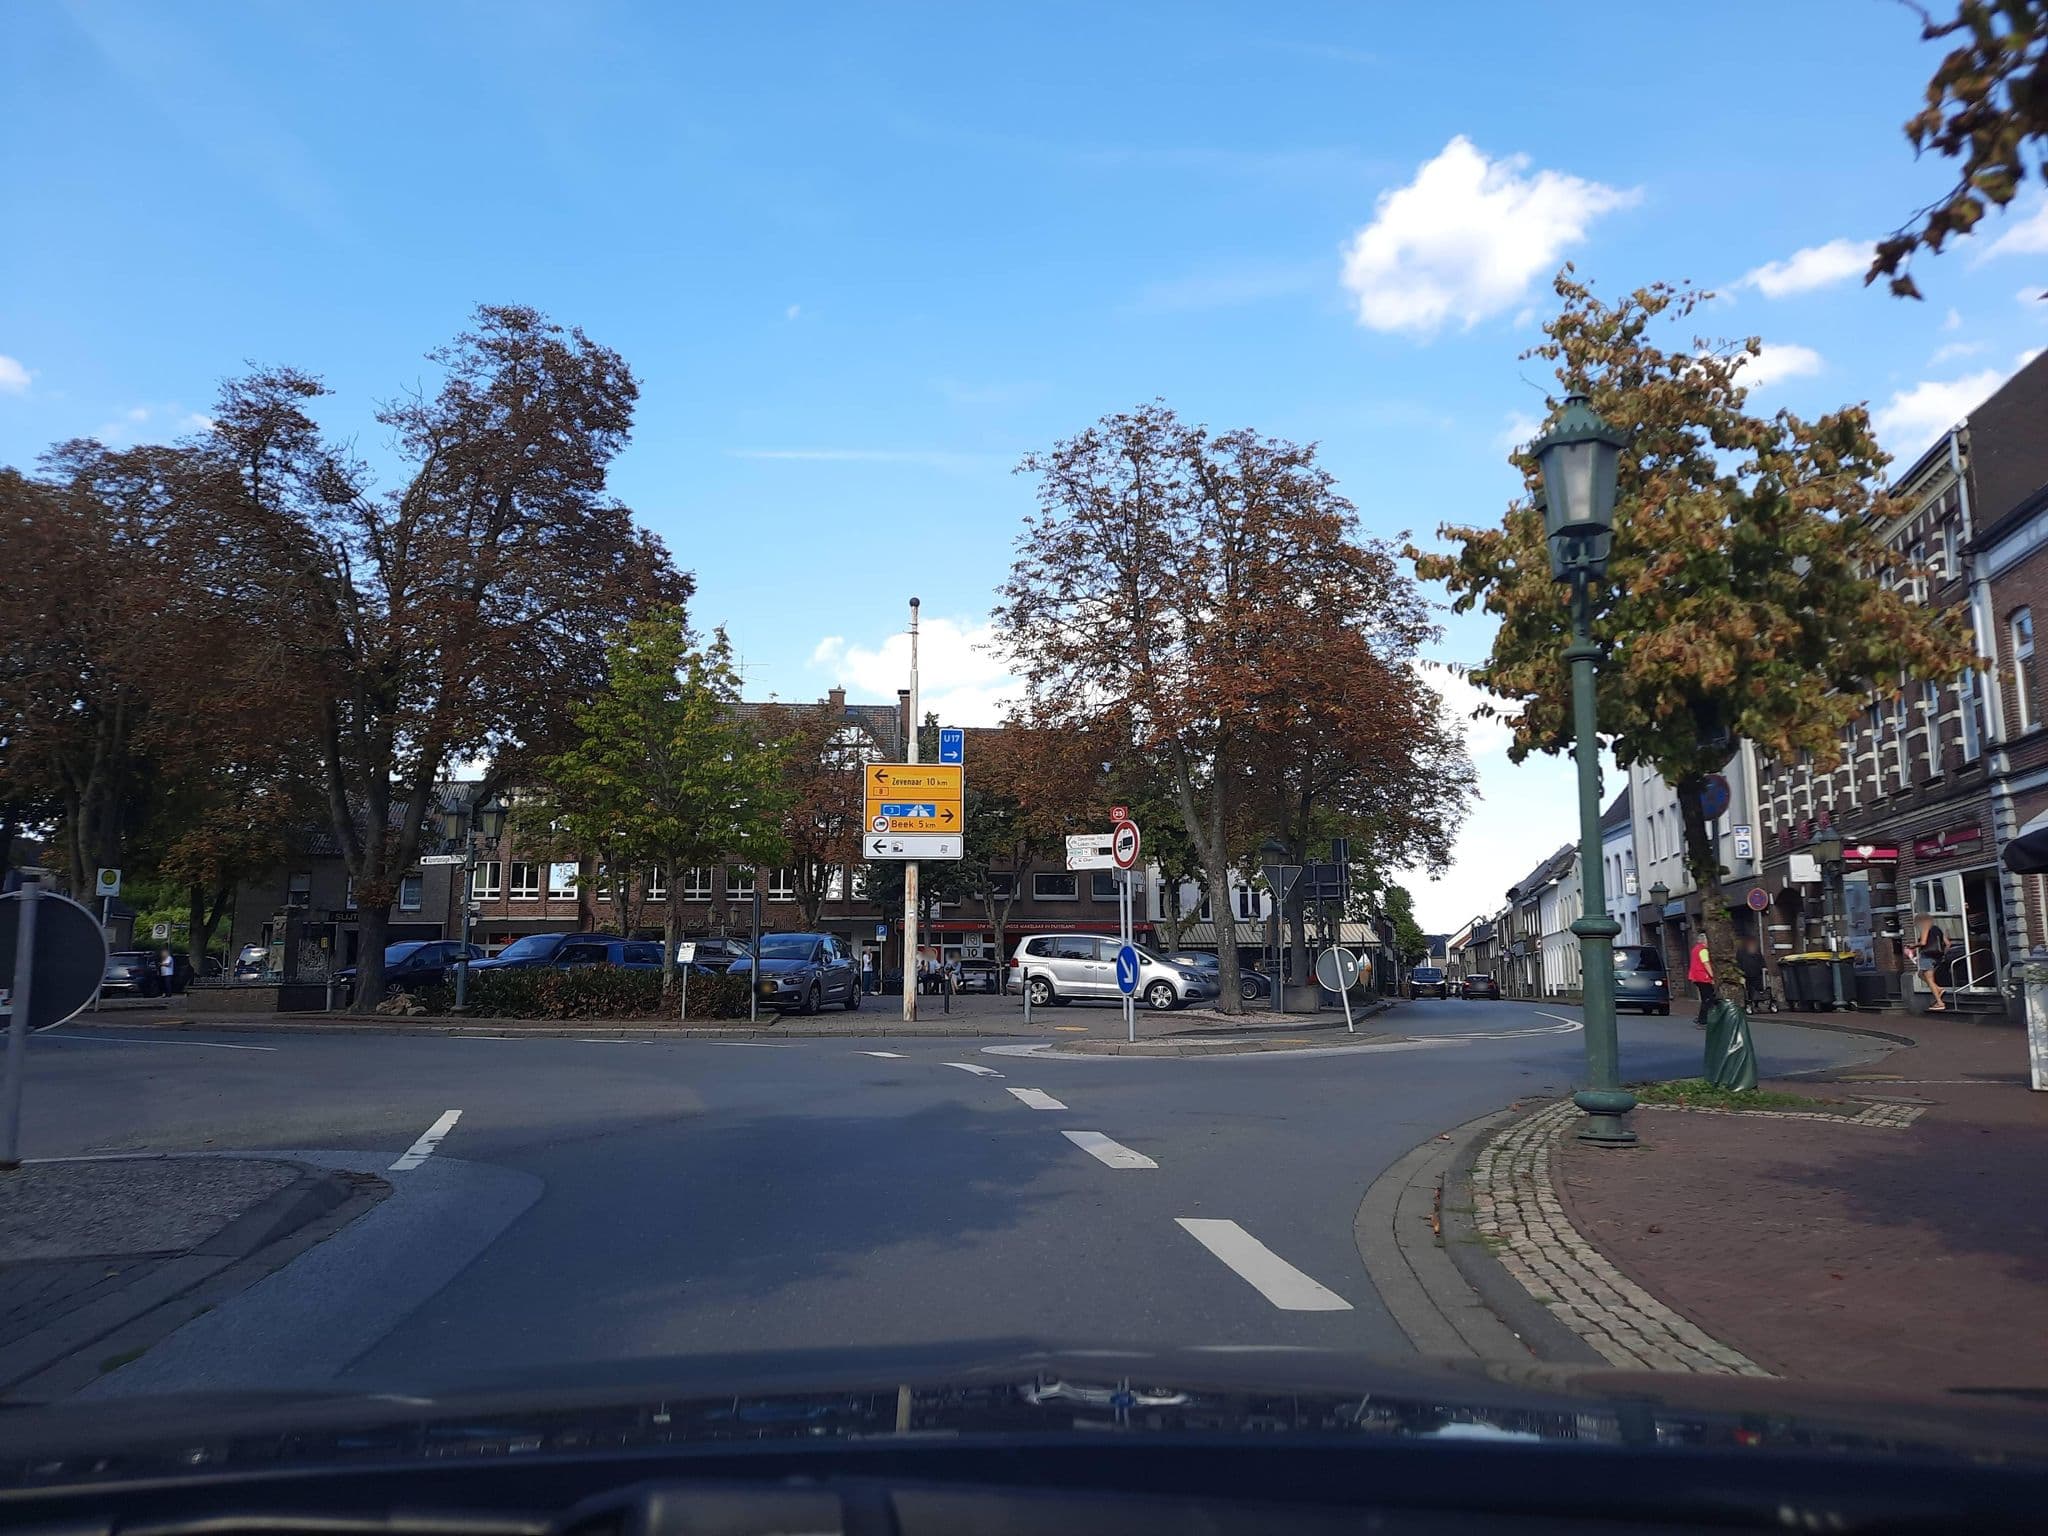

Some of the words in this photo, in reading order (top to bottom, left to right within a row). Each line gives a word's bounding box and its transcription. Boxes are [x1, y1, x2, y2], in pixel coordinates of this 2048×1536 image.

[892, 777, 922, 786] Zevenaar
[926, 778, 936, 786] 10
[891, 820, 914, 828] Beek
[918, 820, 924, 828] 5
[967, 948, 977, 957] 10
